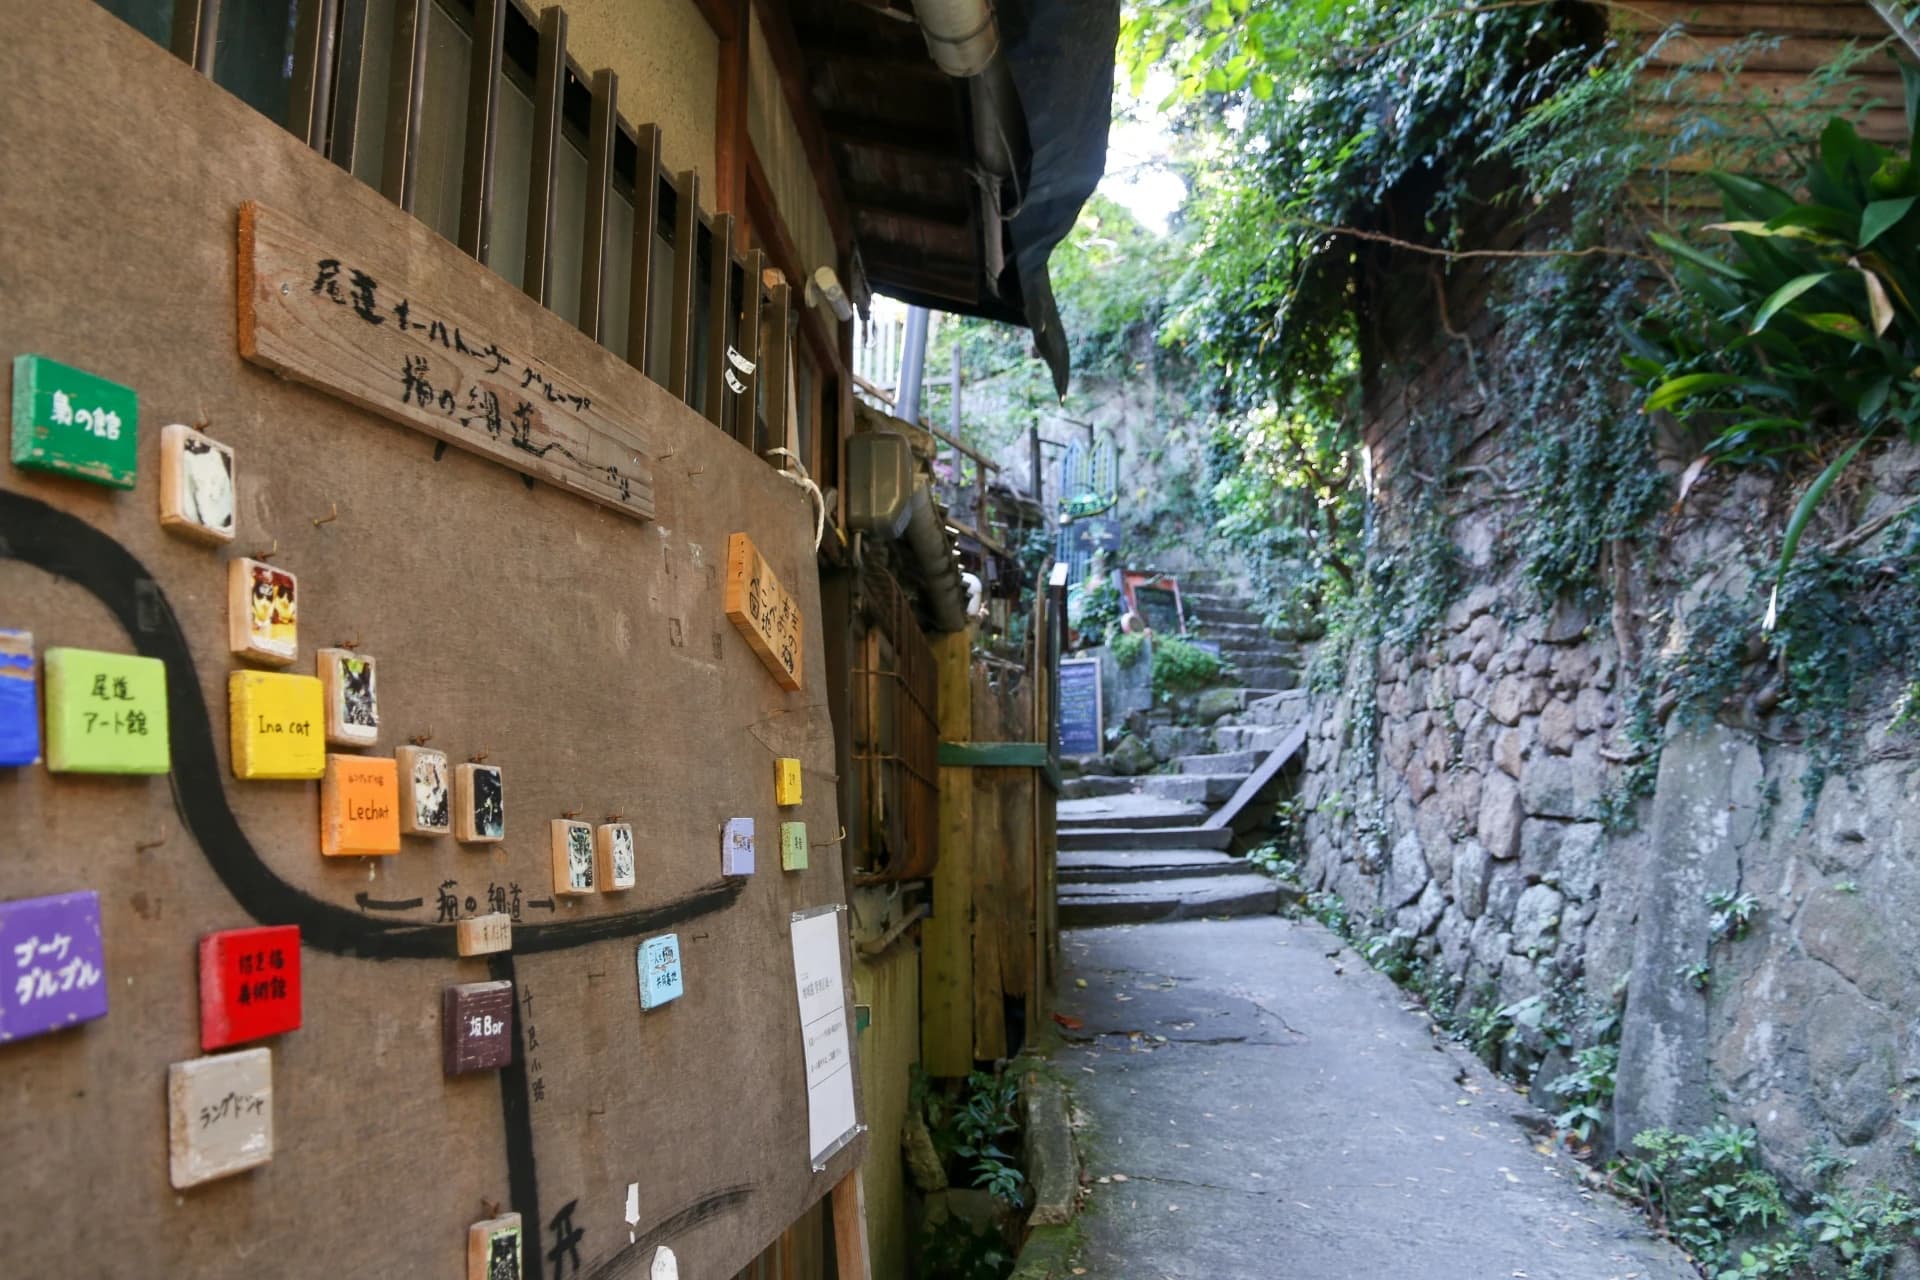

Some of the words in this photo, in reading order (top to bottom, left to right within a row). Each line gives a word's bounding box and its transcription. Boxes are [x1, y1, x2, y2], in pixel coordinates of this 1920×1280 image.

[91, 674, 135, 701] 尾道
[83, 709, 149, 736] アート館
[258, 715, 284, 734] Ina
[289, 718, 311, 737] cat
[14, 933, 72, 967] ブーケ
